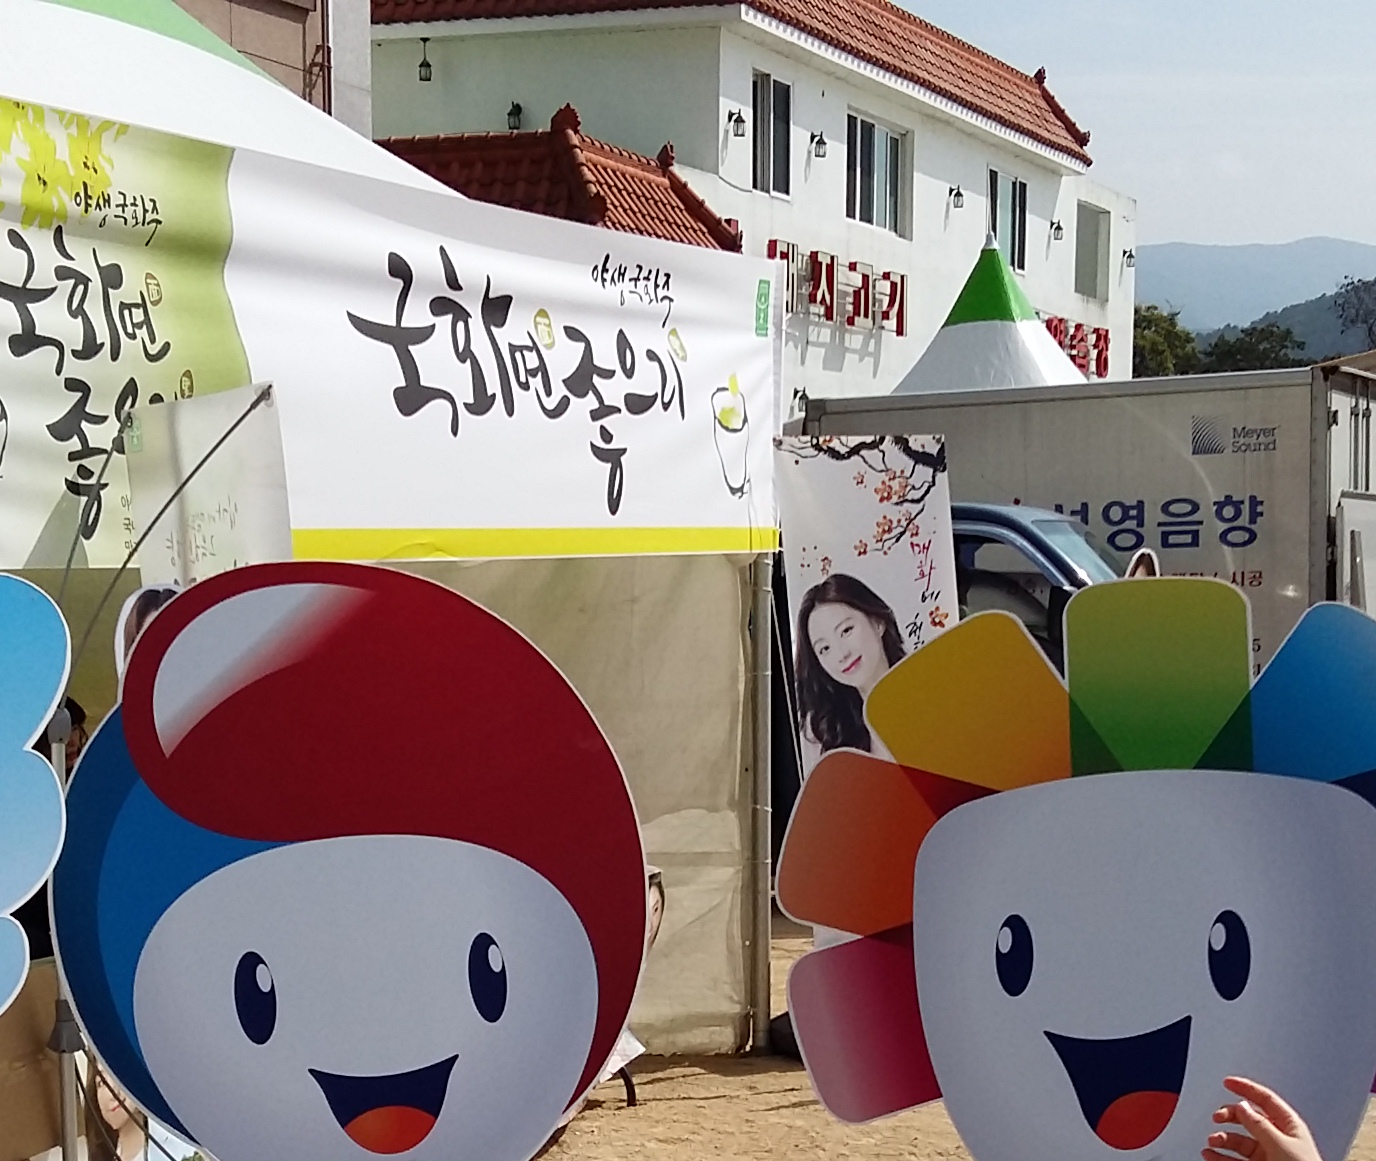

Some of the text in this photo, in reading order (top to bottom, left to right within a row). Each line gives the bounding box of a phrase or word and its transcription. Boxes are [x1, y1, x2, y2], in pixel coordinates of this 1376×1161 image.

[1232, 425, 1277, 441] Meyer
[1231, 439, 1277, 454] Sound
[1231, 570, 1264, 588] 시공
